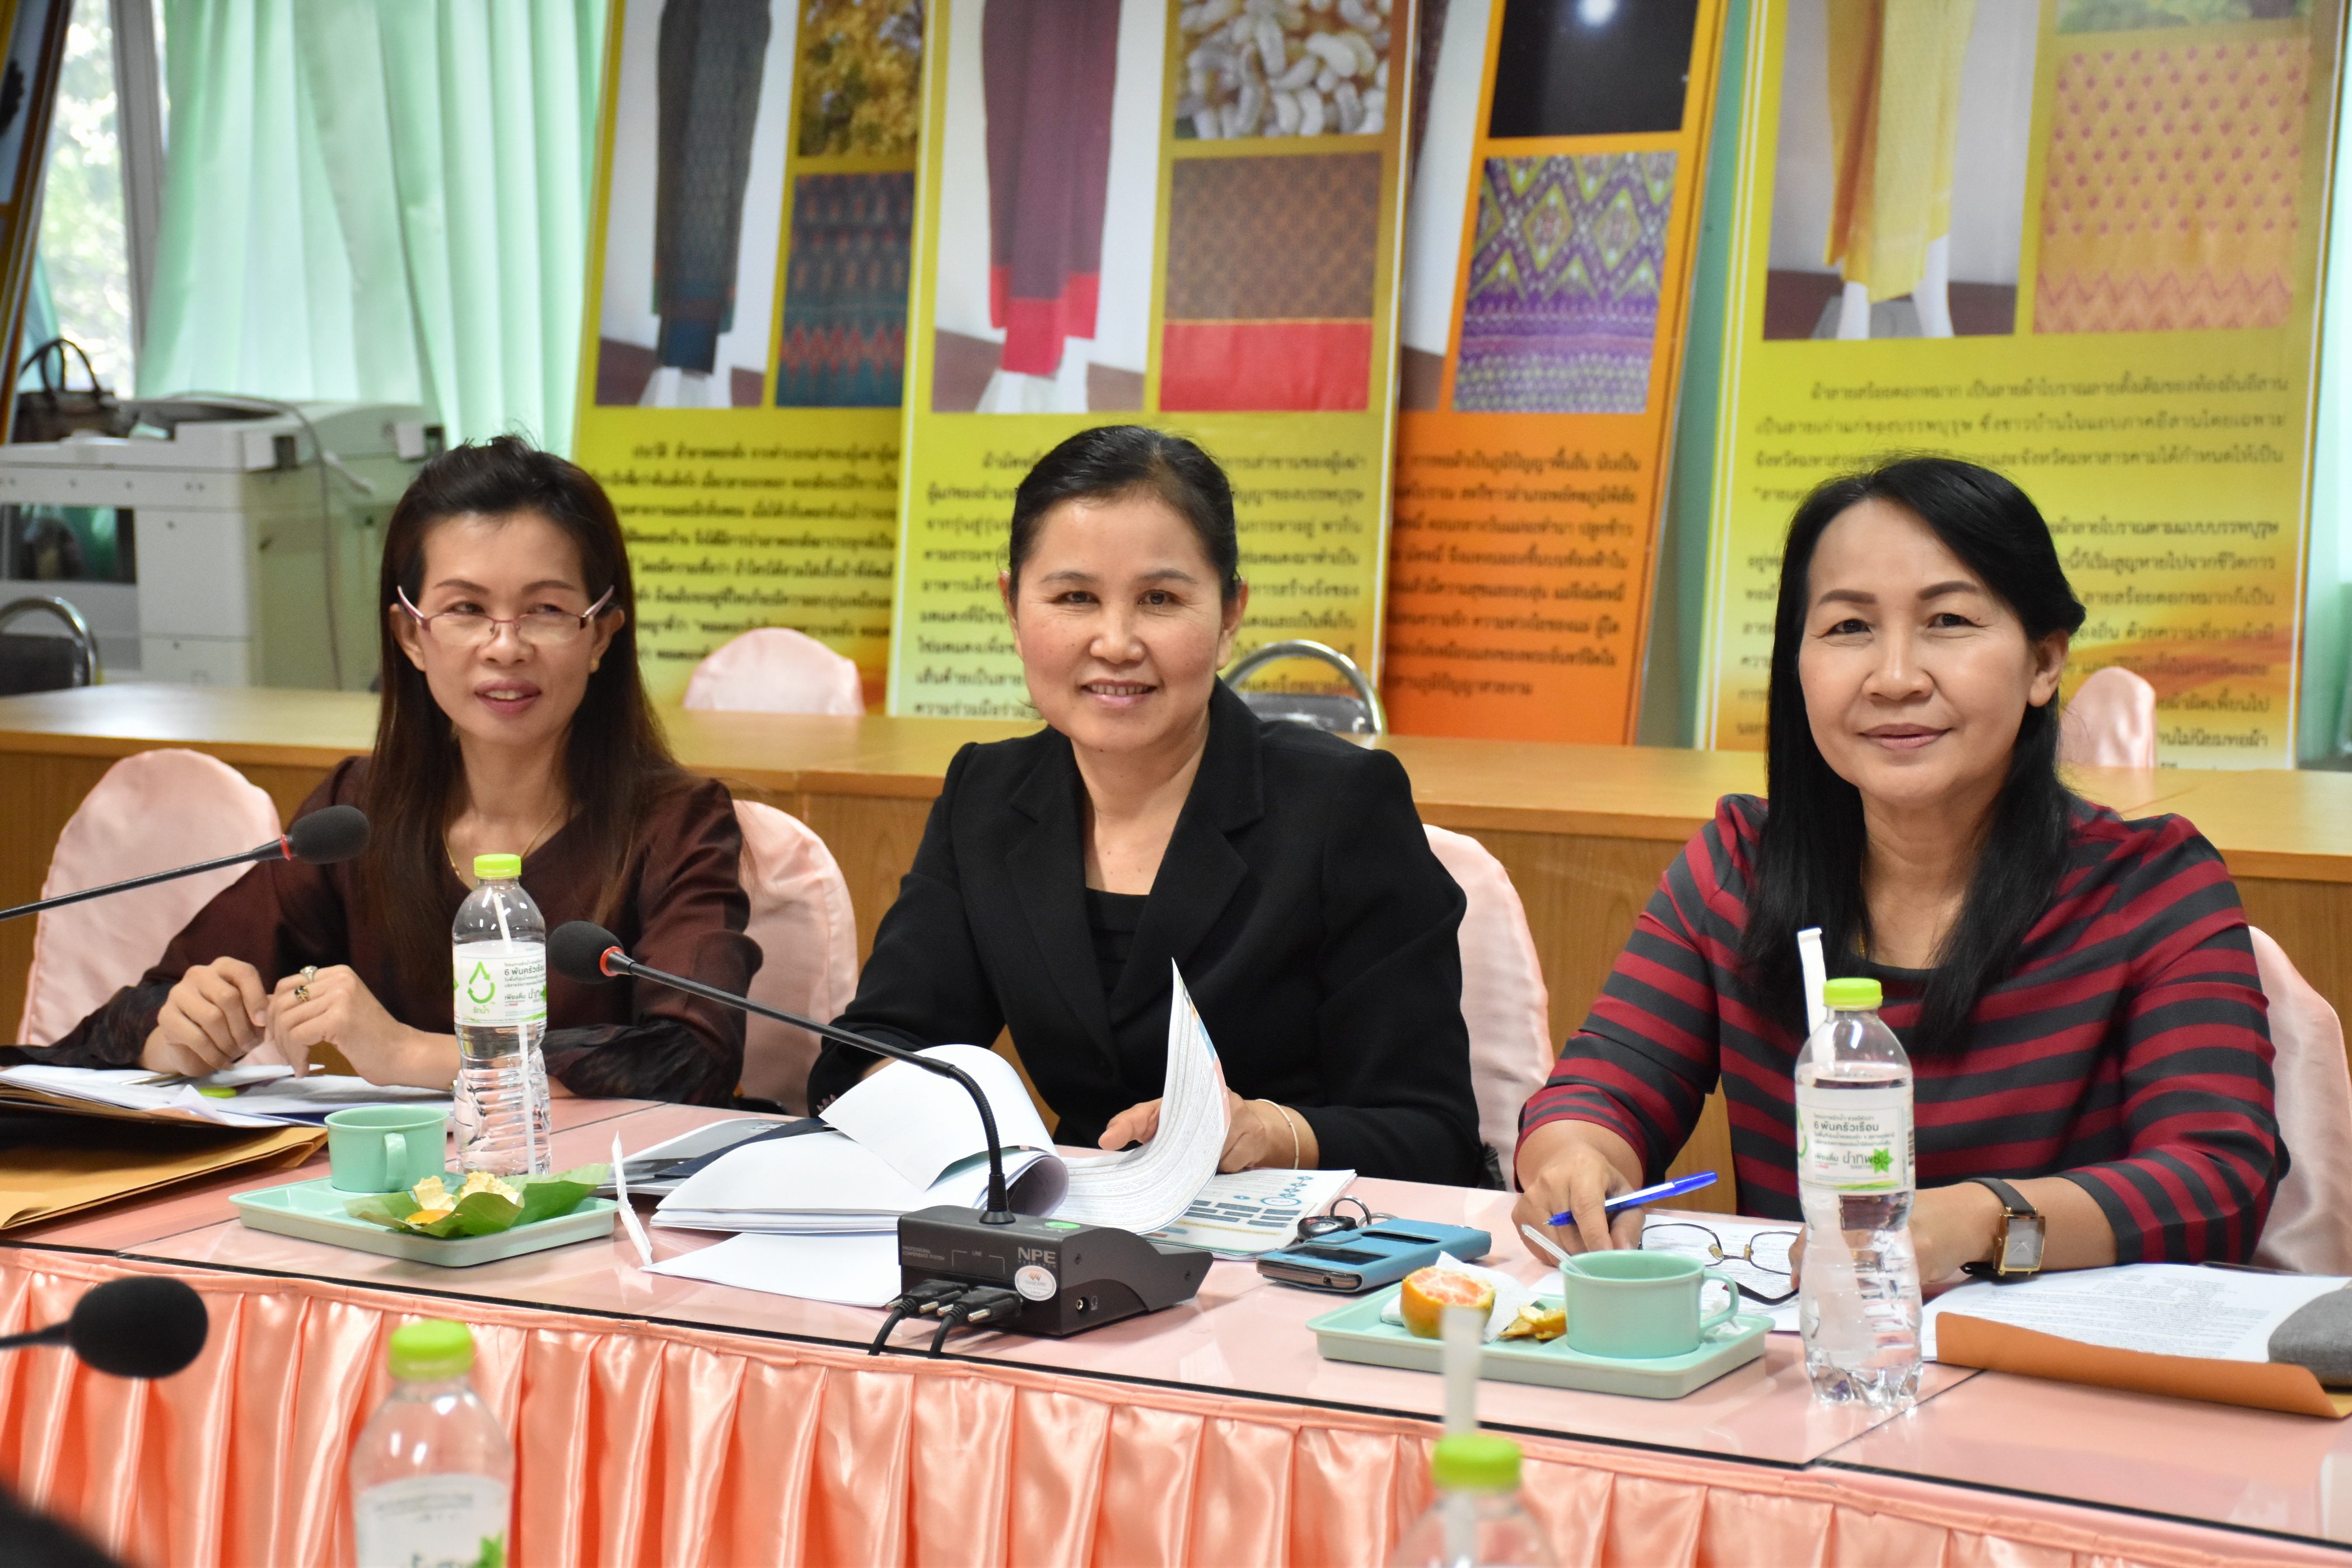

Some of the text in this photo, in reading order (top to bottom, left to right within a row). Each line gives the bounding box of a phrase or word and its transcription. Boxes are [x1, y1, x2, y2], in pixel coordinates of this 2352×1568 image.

[511, 964, 545, 975] พันครัวเรือ
[473, 1005, 490, 1014] รักน้ำ
[1821, 1121, 1879, 1132] พันครัวเรือน
[1018, 1247, 1056, 1264] NPE
